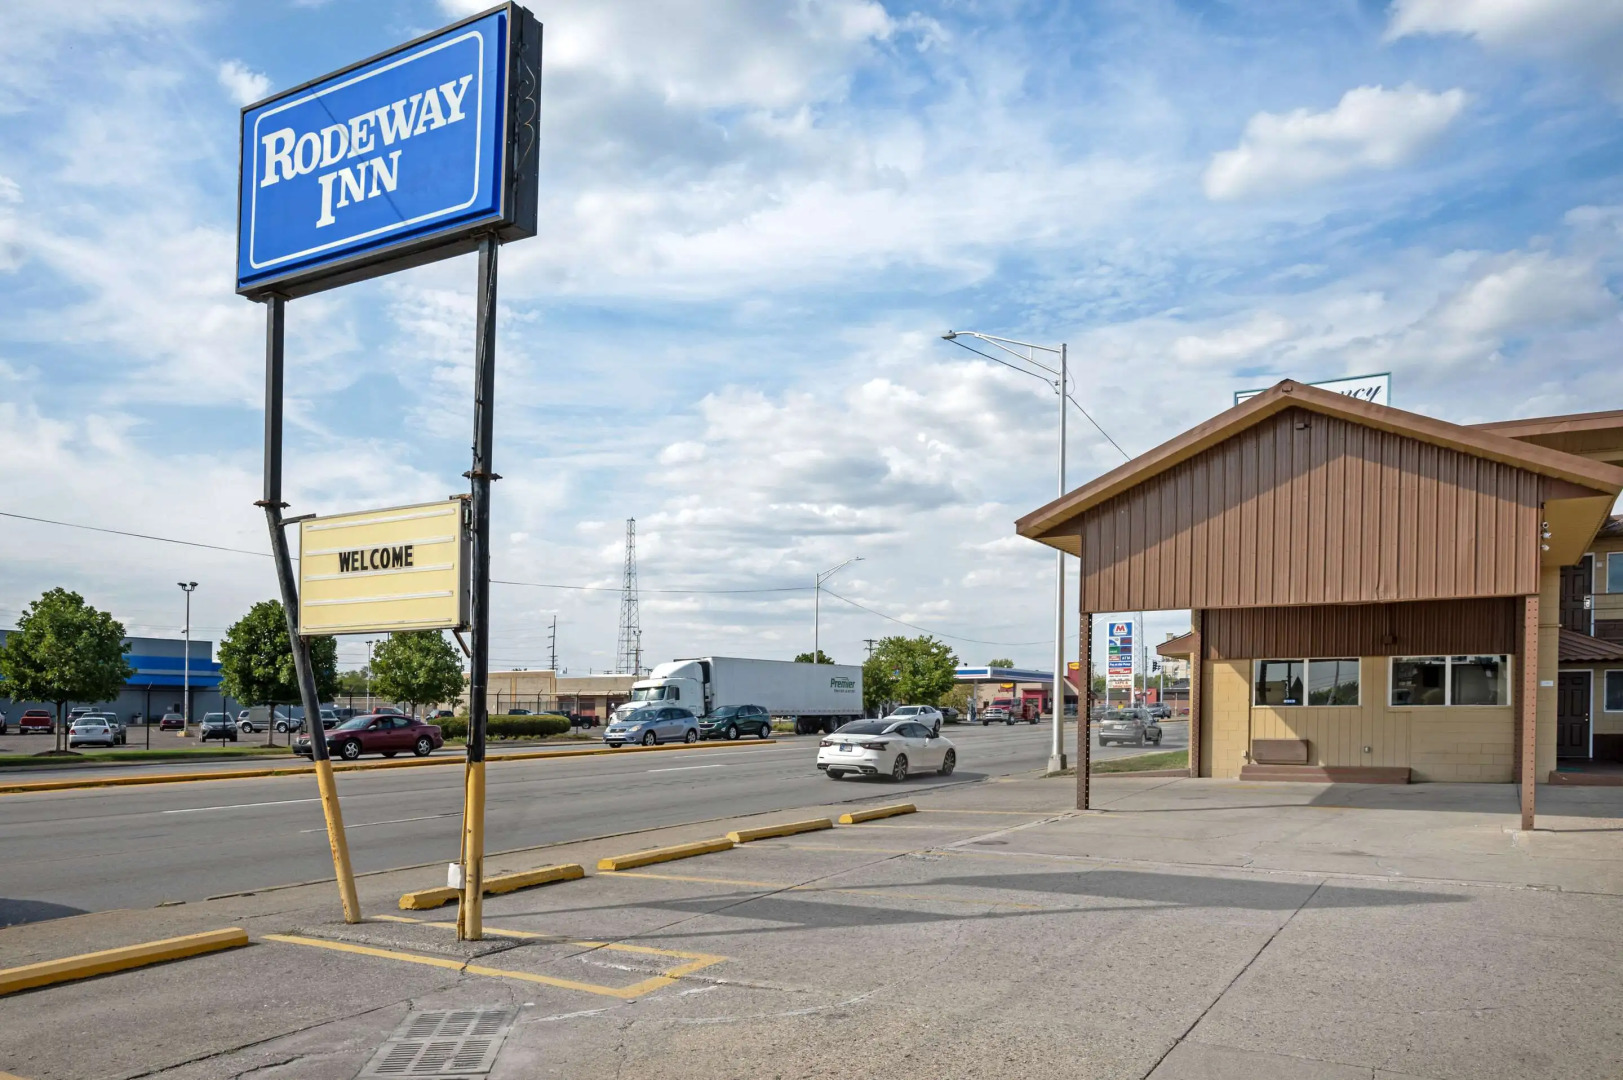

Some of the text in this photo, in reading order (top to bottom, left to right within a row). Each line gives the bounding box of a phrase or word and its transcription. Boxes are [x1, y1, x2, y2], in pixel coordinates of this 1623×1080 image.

[260, 74, 472, 188] RODEWAY
[316, 150, 402, 228] INN
[339, 545, 414, 573] WELCOME
[830, 677, 856, 688] Premier
